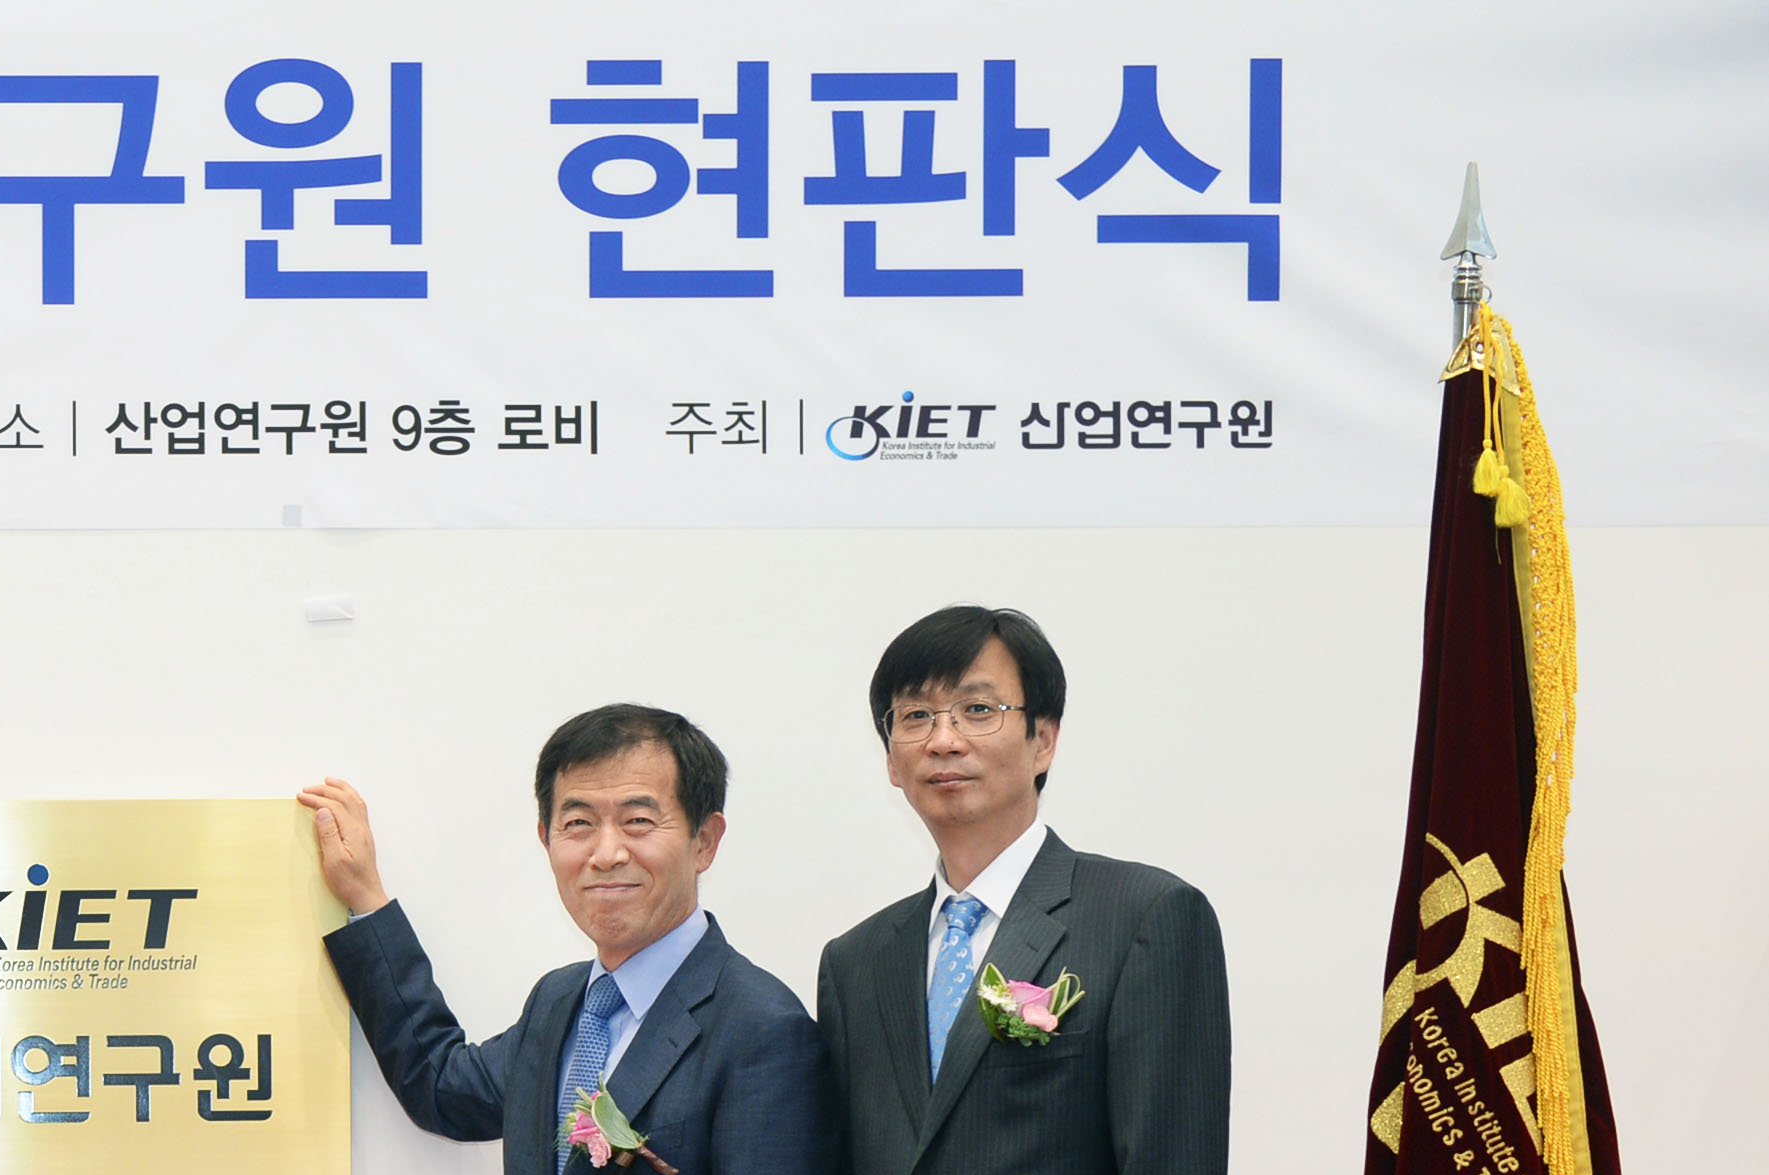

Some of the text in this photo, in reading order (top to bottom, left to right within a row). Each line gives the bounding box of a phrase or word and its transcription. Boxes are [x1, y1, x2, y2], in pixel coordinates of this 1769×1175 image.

[549, 57, 1283, 302] 현판식
[105, 400, 368, 456] 산업연구원
[391, 400, 476, 456] 9층
[497, 400, 598, 455] 로비
[665, 400, 767, 455] 주최
[1020, 400, 1273, 450] 산업연구원
[879, 451, 959, 461] Economics & Trade
[883, 441, 996, 451] Korea Institute for Industrial
[38, 955, 100, 972] Institute
[103, 955, 125, 972] for
[127, 954, 198, 972] Industrial
[71, 973, 84, 990] &
[89, 973, 129, 990] Trade
[1414, 1006, 1465, 1081] Korea
[1454, 1077, 1520, 1175] Institute
[1453, 1149, 1475, 1171] &
